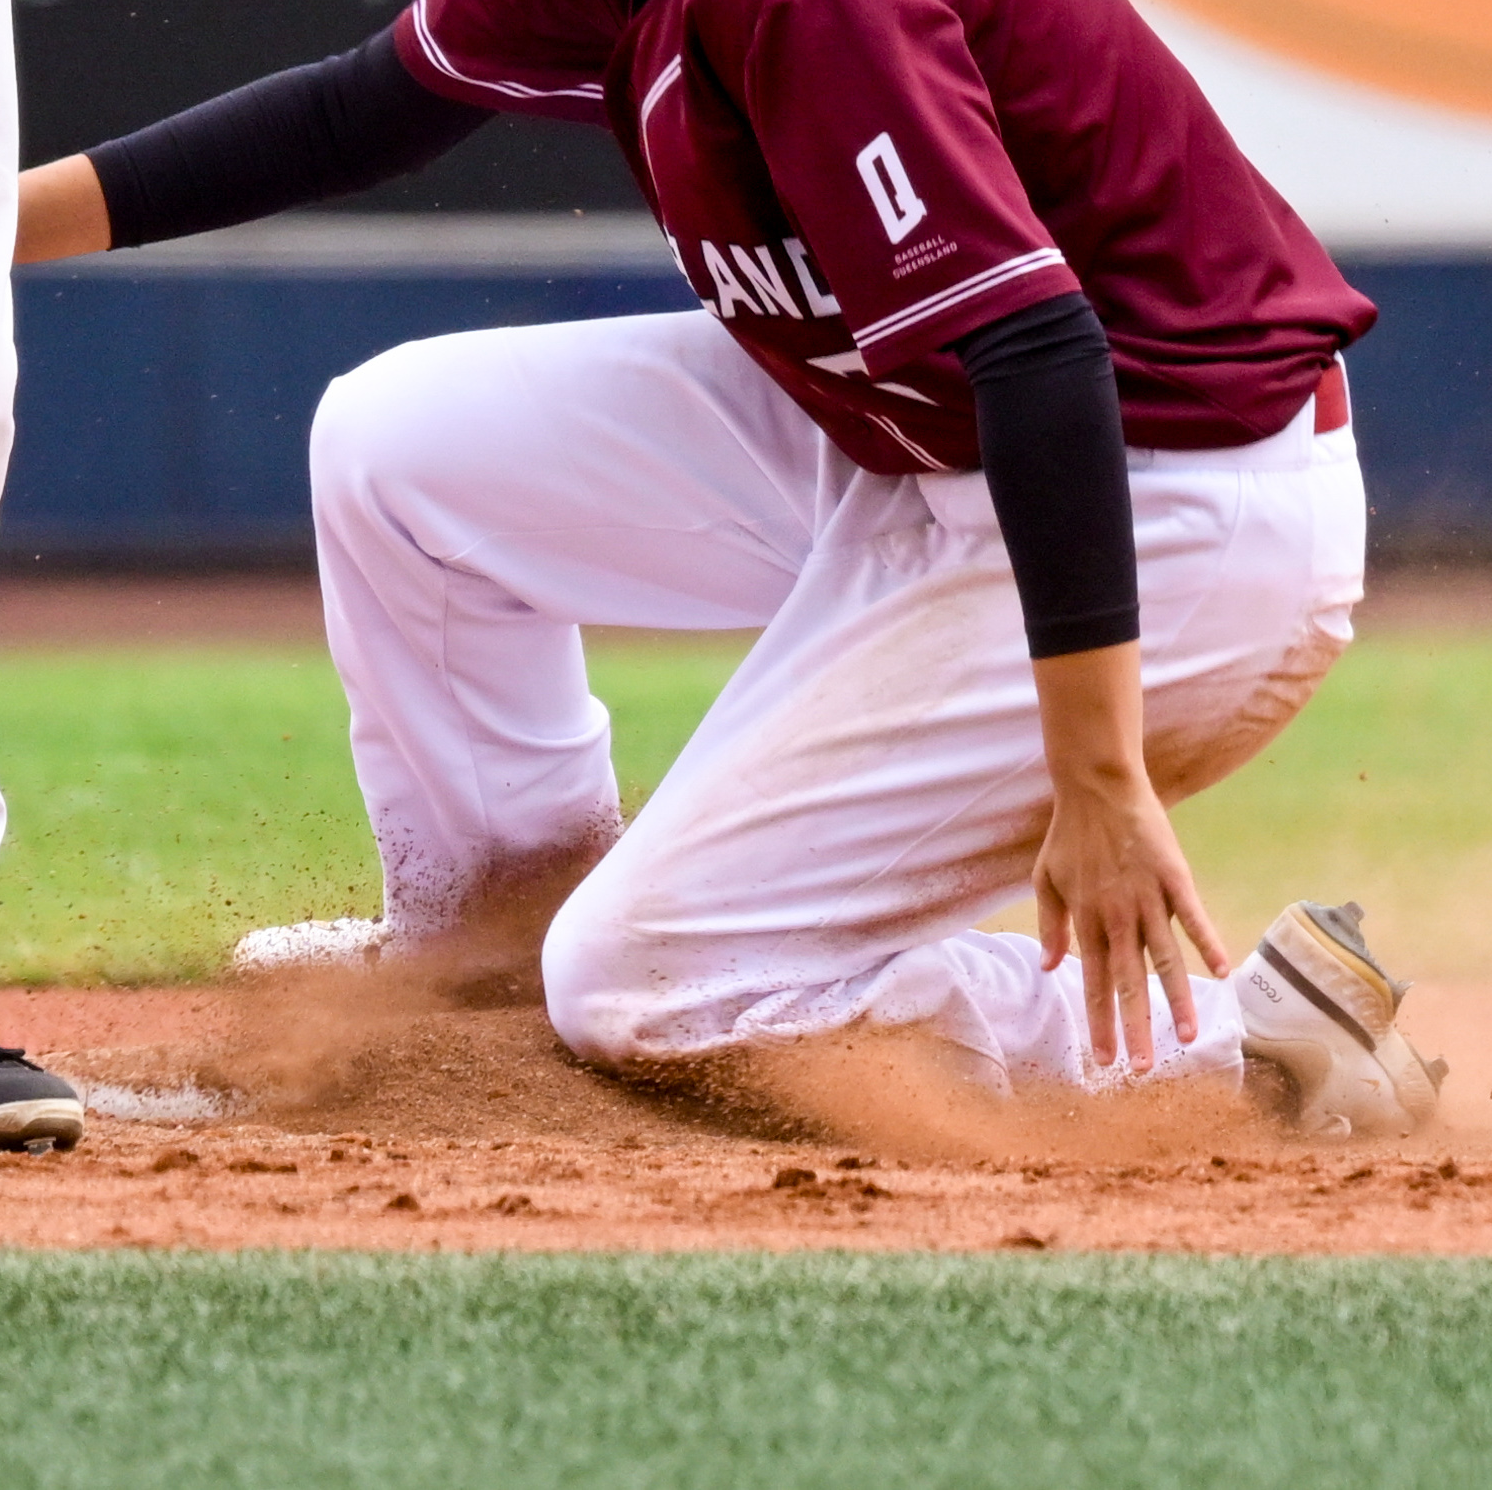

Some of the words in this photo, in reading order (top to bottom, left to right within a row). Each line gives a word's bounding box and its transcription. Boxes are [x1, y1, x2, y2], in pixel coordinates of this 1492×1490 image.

[855, 131, 928, 245] Q
[892, 241, 958, 280] QUEENSLAND
[894, 234, 945, 265] BASEBALL
